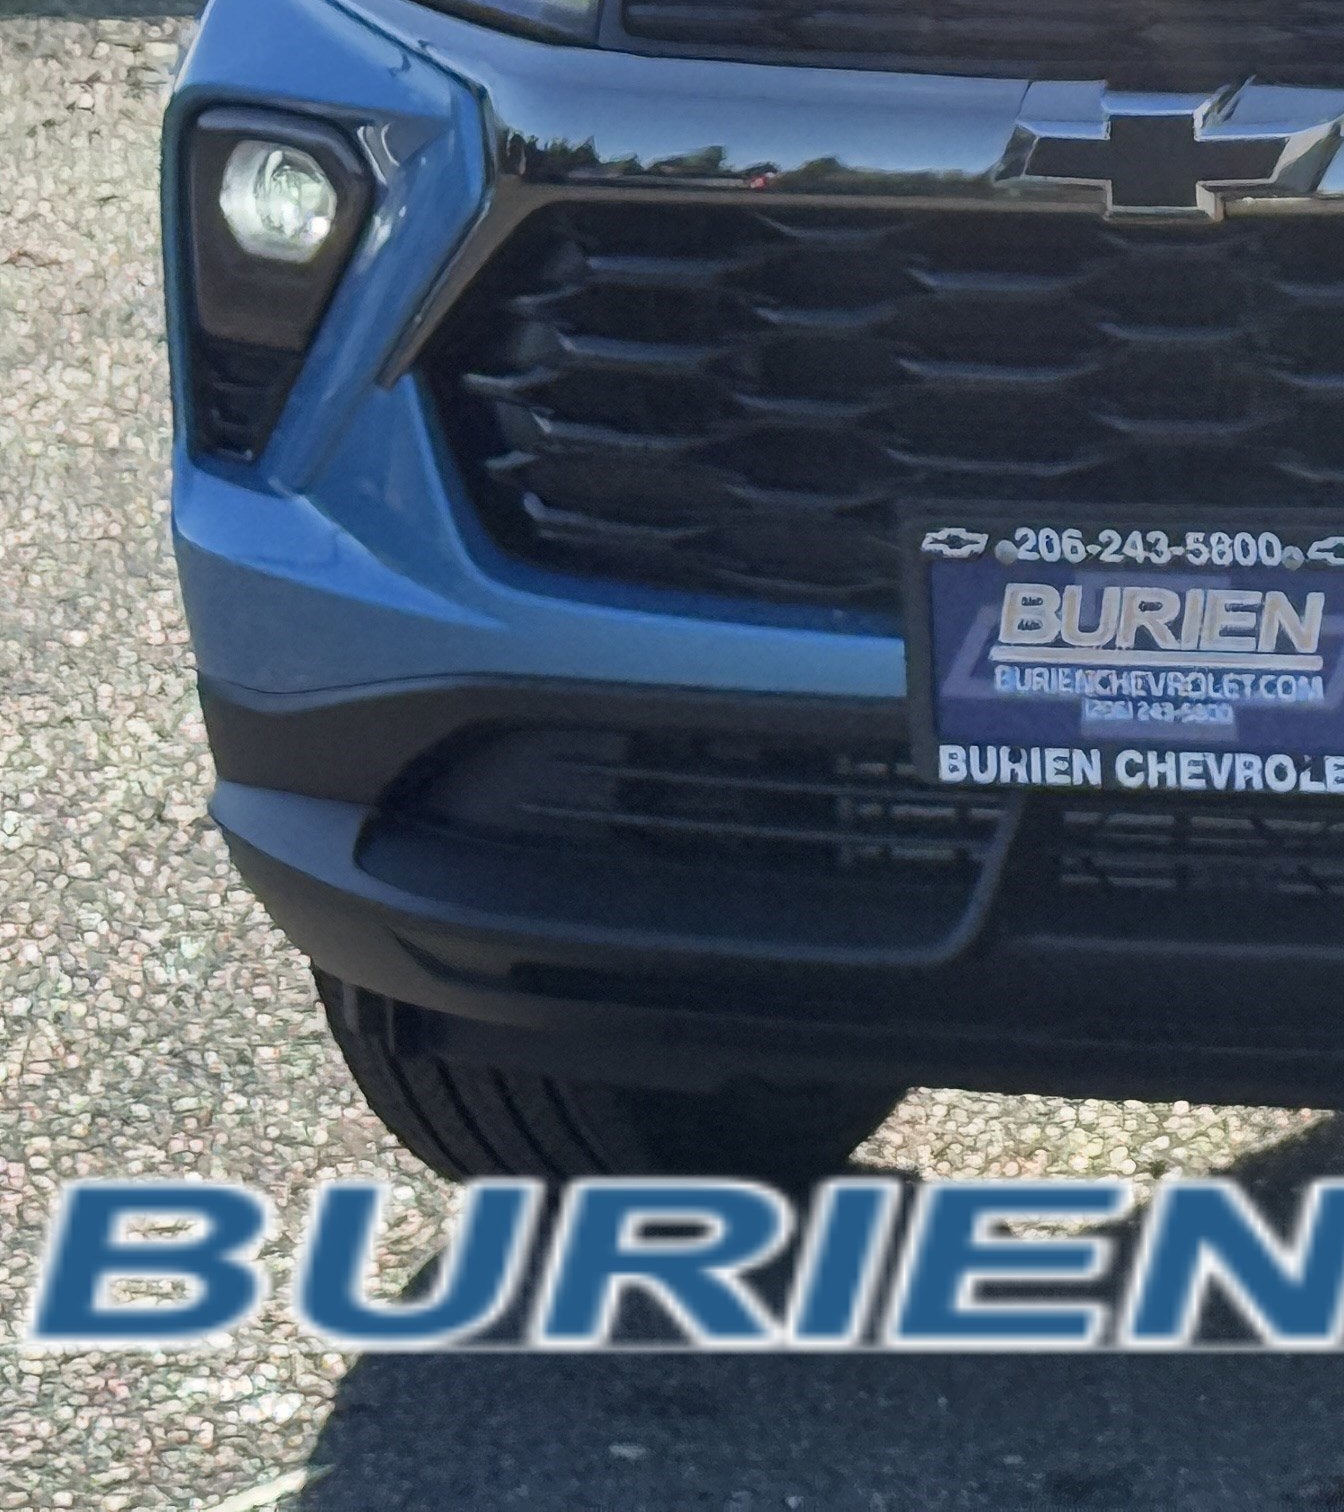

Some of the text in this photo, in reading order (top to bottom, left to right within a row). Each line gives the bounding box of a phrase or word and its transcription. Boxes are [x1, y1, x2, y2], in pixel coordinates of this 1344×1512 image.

[1013, 525, 1283, 568] 206-243-5800
[997, 582, 1326, 654] BURIEN
[938, 744, 1102, 787] BURIEN
